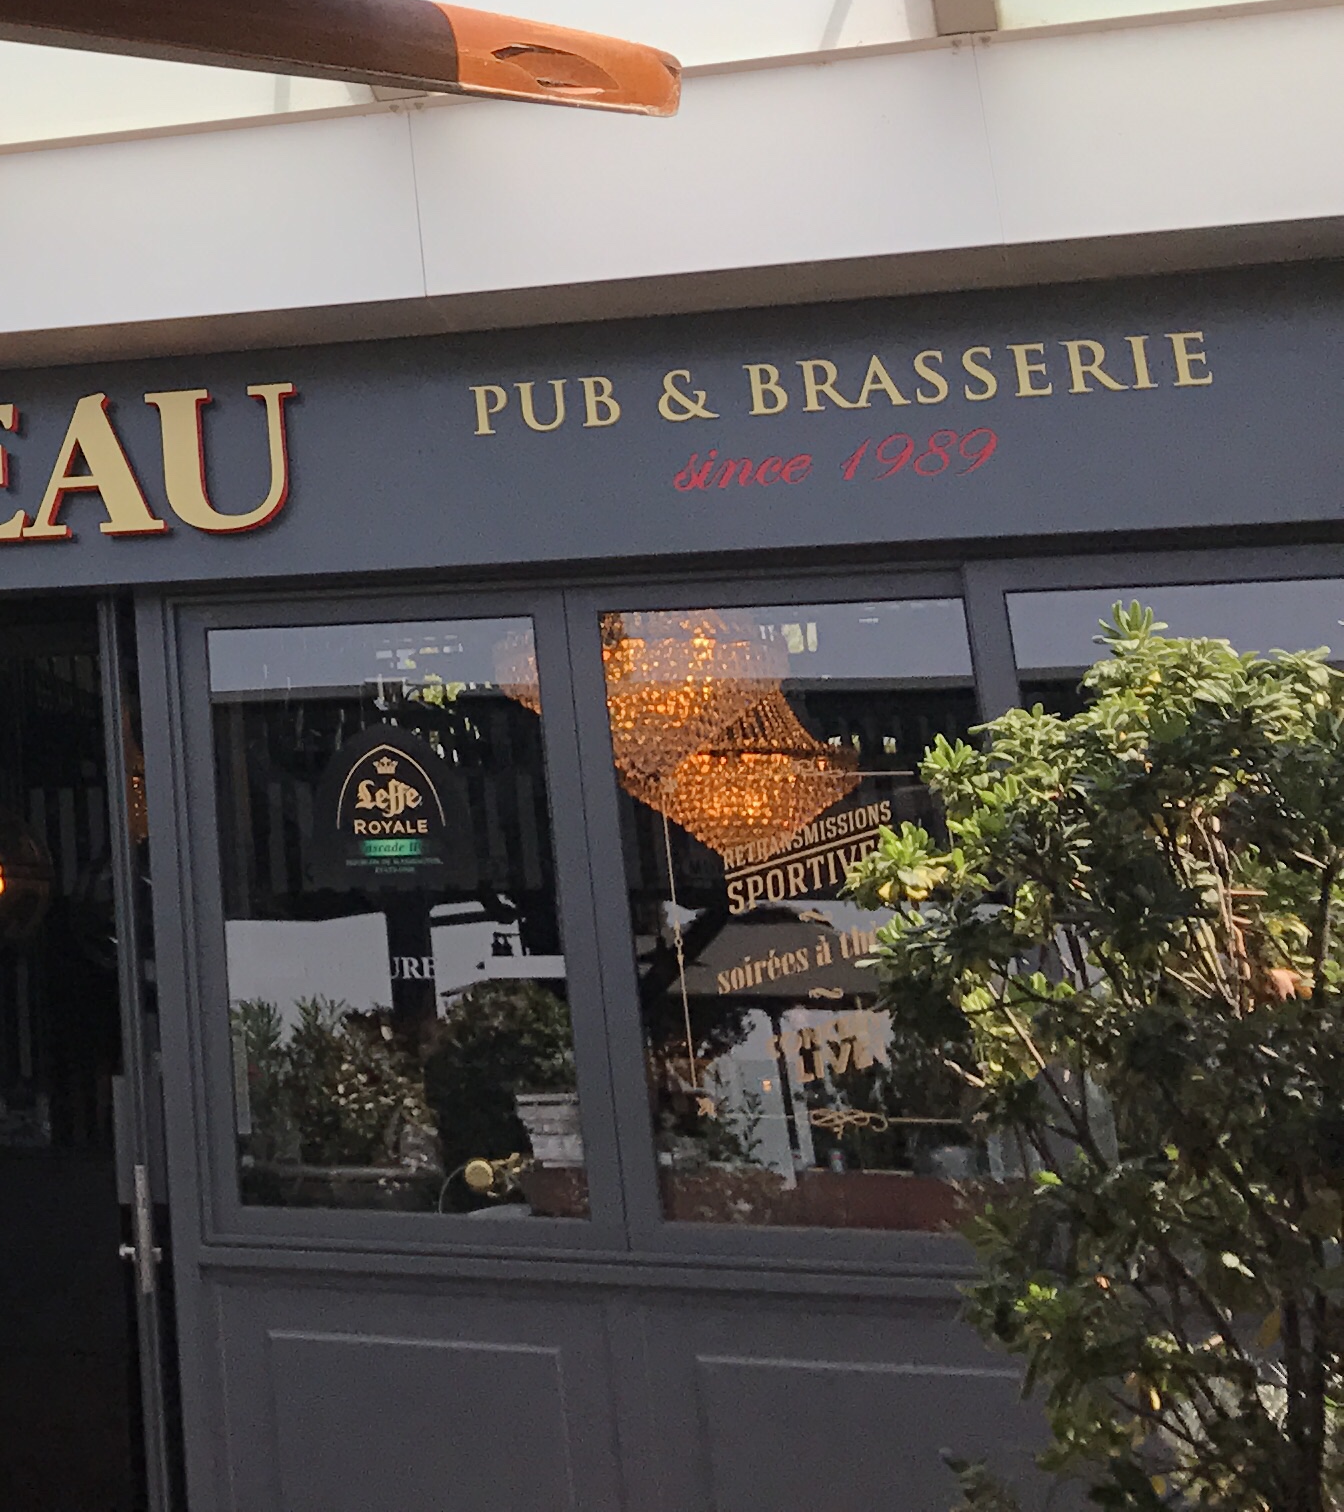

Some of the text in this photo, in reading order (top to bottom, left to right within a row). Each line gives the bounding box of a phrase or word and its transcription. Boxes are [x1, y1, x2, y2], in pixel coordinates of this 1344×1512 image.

[468, 330, 1215, 436] PUB & BRASSERIE
[672, 426, 1000, 492] since 1989
[353, 818, 429, 835] ROYALE
[355, 777, 423, 818] Leffe
[723, 799, 892, 871] RETRANSMISSIONS
[727, 838, 884, 915] SPORTIVE
[717, 946, 809, 995] soirées
